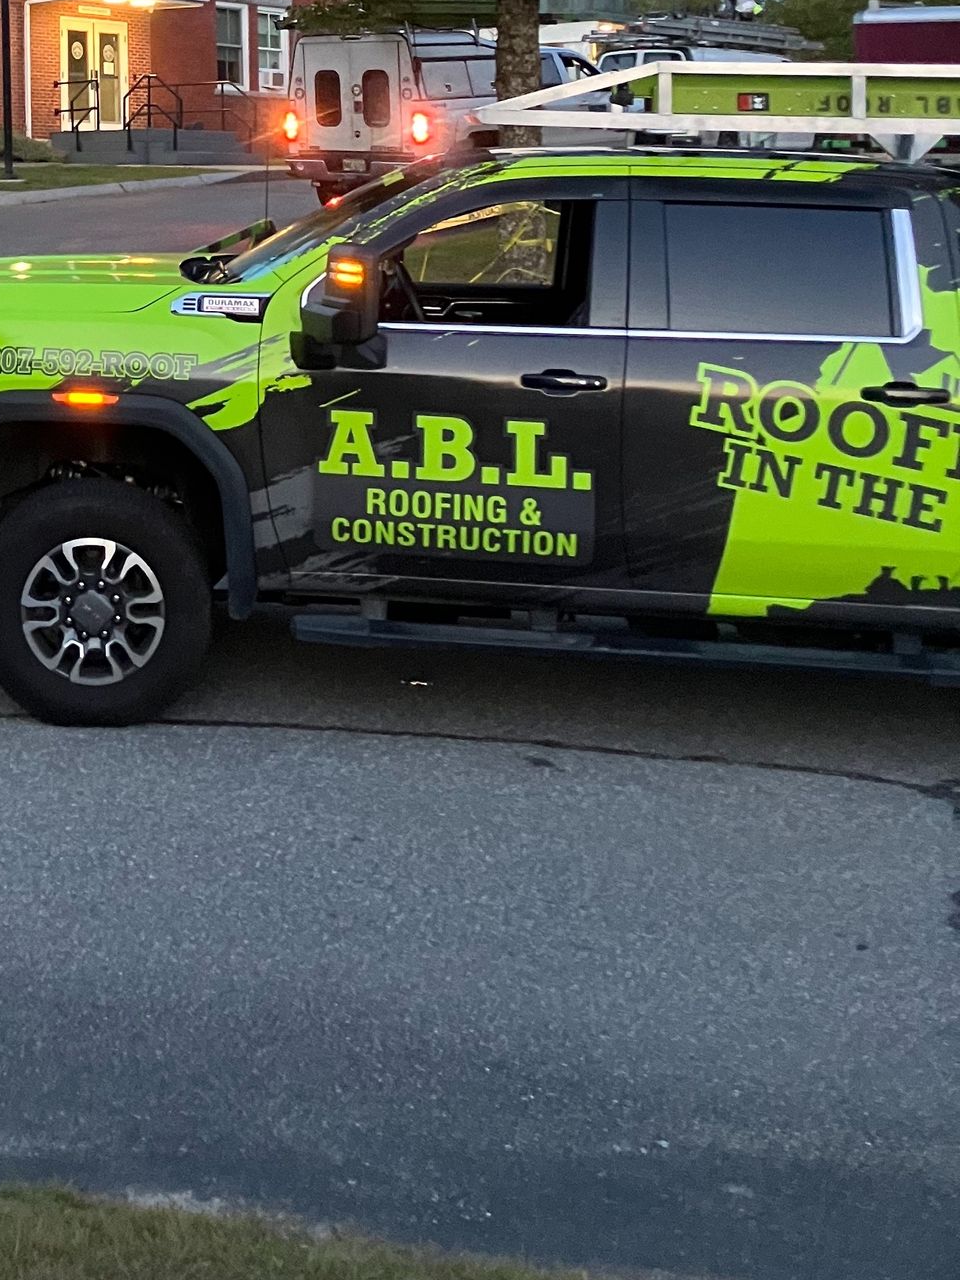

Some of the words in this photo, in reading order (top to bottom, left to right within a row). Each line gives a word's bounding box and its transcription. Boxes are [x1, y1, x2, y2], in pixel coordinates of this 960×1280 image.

[916, 95, 960, 115] BL
[208, 299, 255, 307] DURAMAX
[318, 410, 592, 491] A.B.L.
[718, 438, 803, 500] IN
[814, 462, 949, 534] THE
[366, 488, 506, 523] ROOFING
[520, 498, 542, 526] &
[331, 517, 578, 558] CONSTRUCTION
